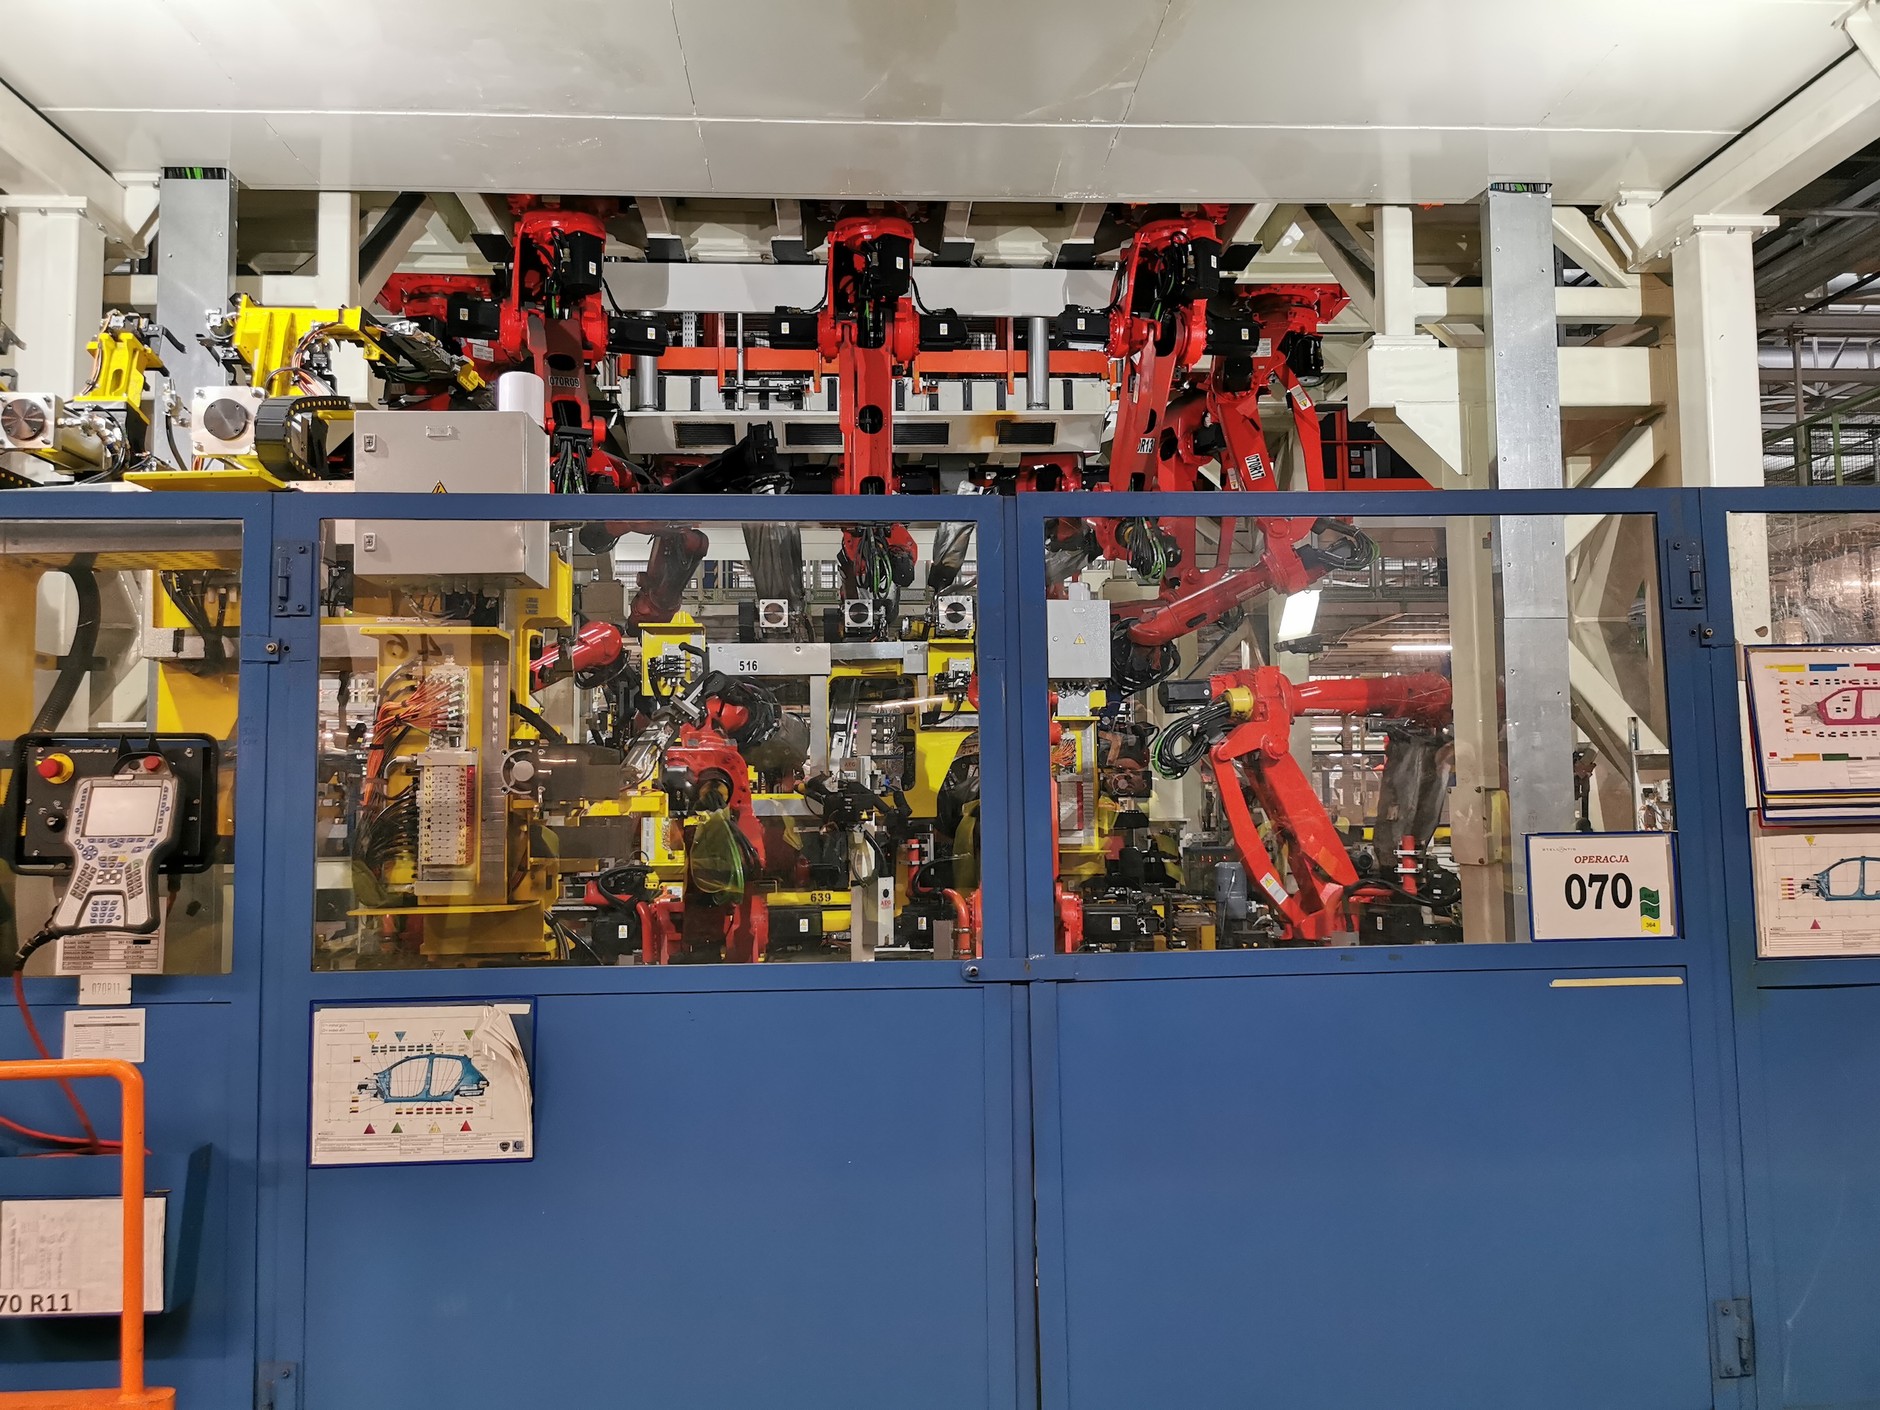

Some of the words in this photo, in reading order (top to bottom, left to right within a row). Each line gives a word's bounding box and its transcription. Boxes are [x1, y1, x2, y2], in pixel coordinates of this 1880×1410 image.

[549, 376, 580, 388] 070R09
[739, 660, 758, 671] 516
[1574, 855, 1630, 864] OPERACJA
[1564, 872, 1633, 910] 070
[810, 892, 831, 902] 639
[30, 1293, 73, 1312] R11
